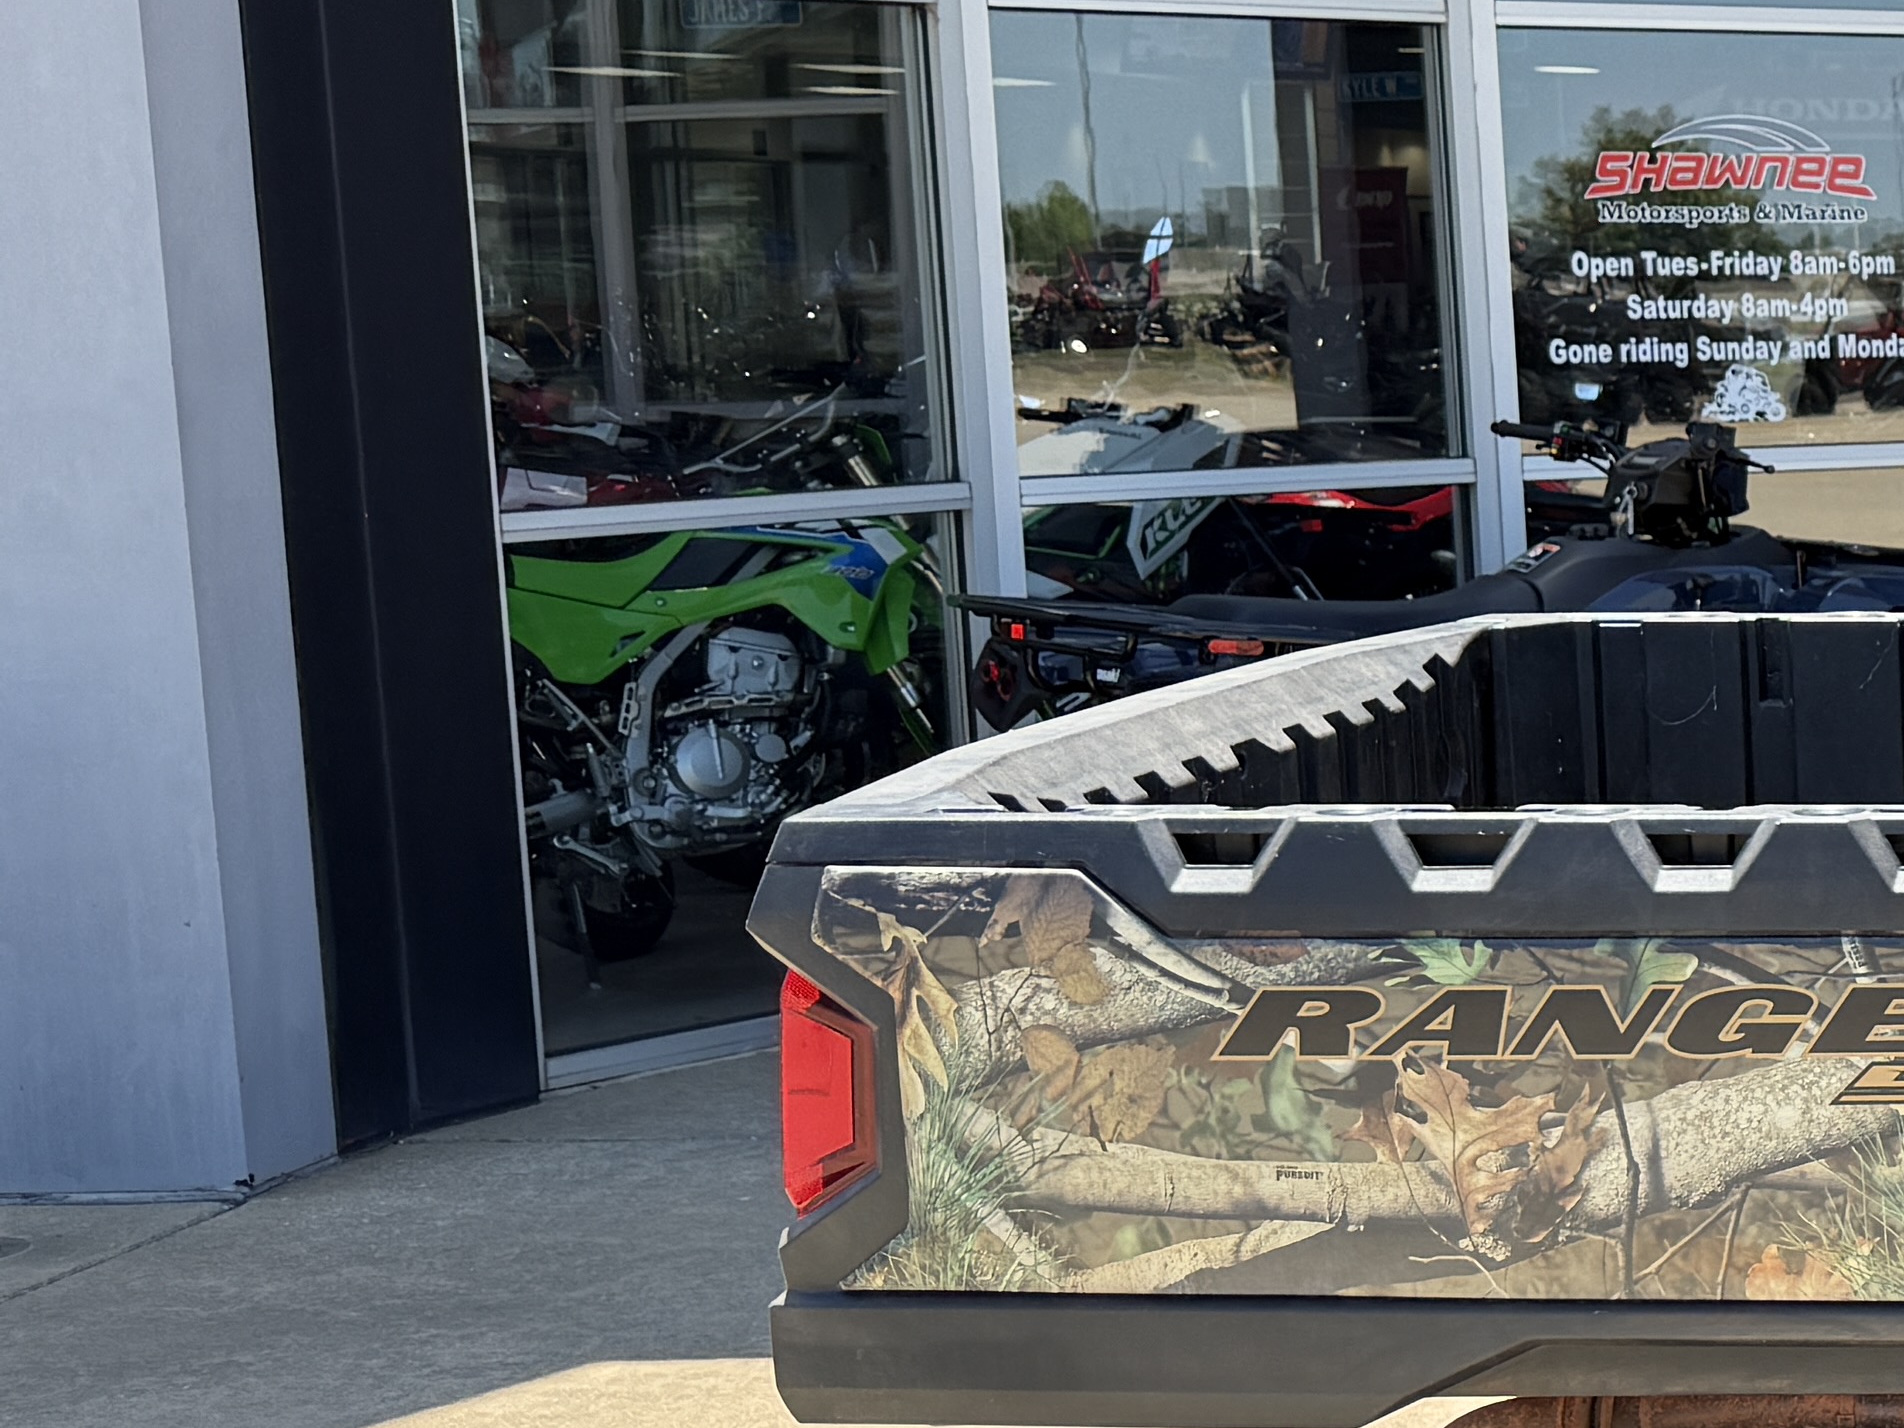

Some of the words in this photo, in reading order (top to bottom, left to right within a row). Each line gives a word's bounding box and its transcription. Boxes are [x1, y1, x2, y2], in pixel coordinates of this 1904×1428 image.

[1597, 199, 1751, 229] Motorsports
[1753, 202, 1775, 224] &
[1775, 200, 1869, 224] Marine
[1570, 250, 1634, 283] Open
[1788, 249, 1896, 280] 8am-6pm
[1626, 292, 1734, 324] Saturday
[1740, 291, 1849, 323] 8am-4pm
[1547, 337, 1613, 366] Gone
[1619, 335, 1689, 368] riding
[1695, 334, 1784, 366] Sunday
[1789, 334, 1831, 361] and
